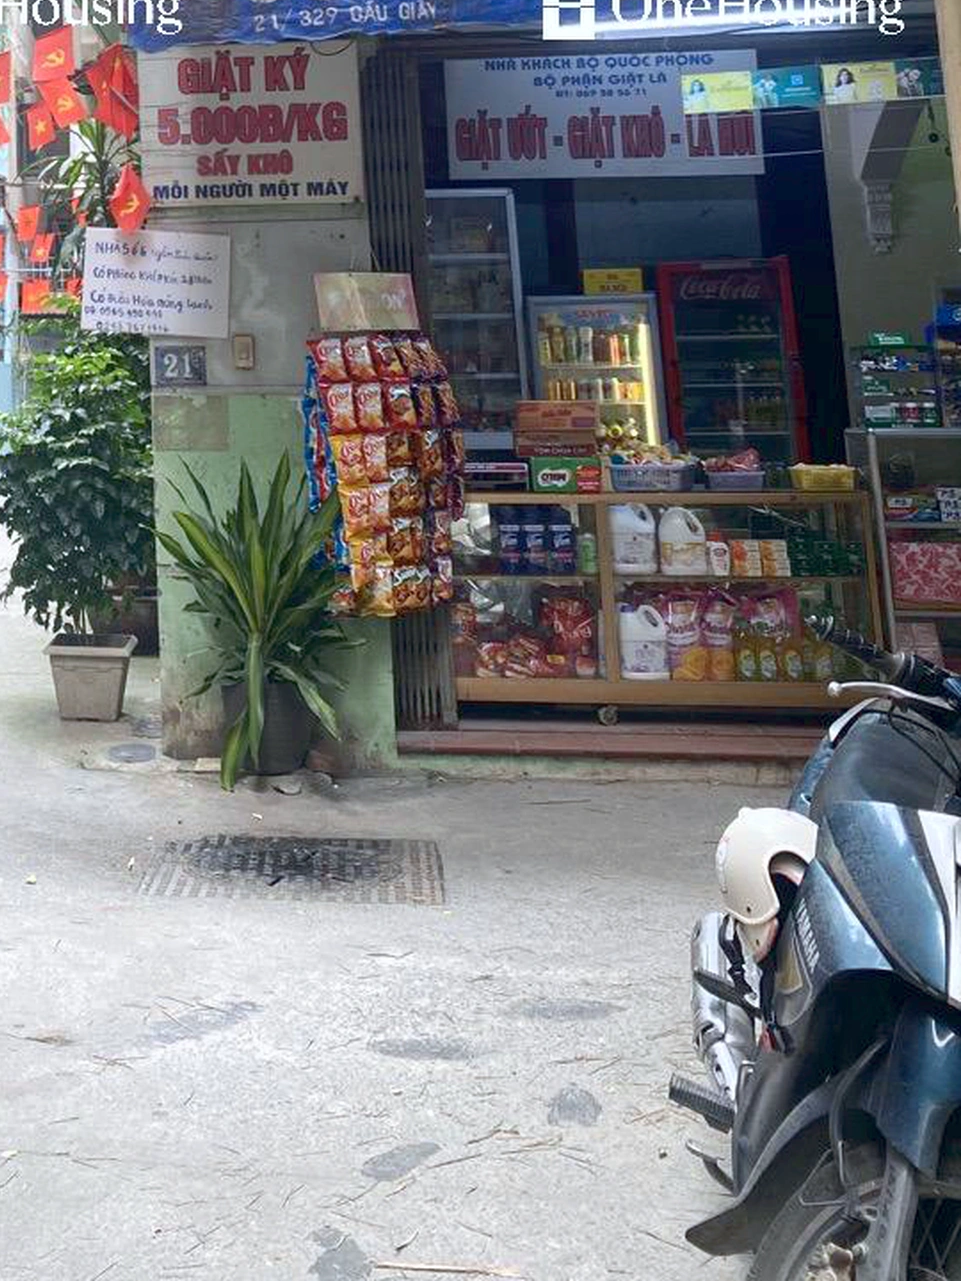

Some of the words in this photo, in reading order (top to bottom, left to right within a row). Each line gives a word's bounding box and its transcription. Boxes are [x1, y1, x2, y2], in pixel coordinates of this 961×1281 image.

[177, 50, 255, 101] GIẶT
[263, 47, 311, 92] KÝ
[247, 149, 294, 176] KHÔ
[455, 109, 503, 170] GIẶT
[567, 106, 616, 168] GIẶT
[620, 105, 667, 159] KHÔ
[163, 353, 194, 378] 21
[795, 897, 820, 974] YAMAHA
